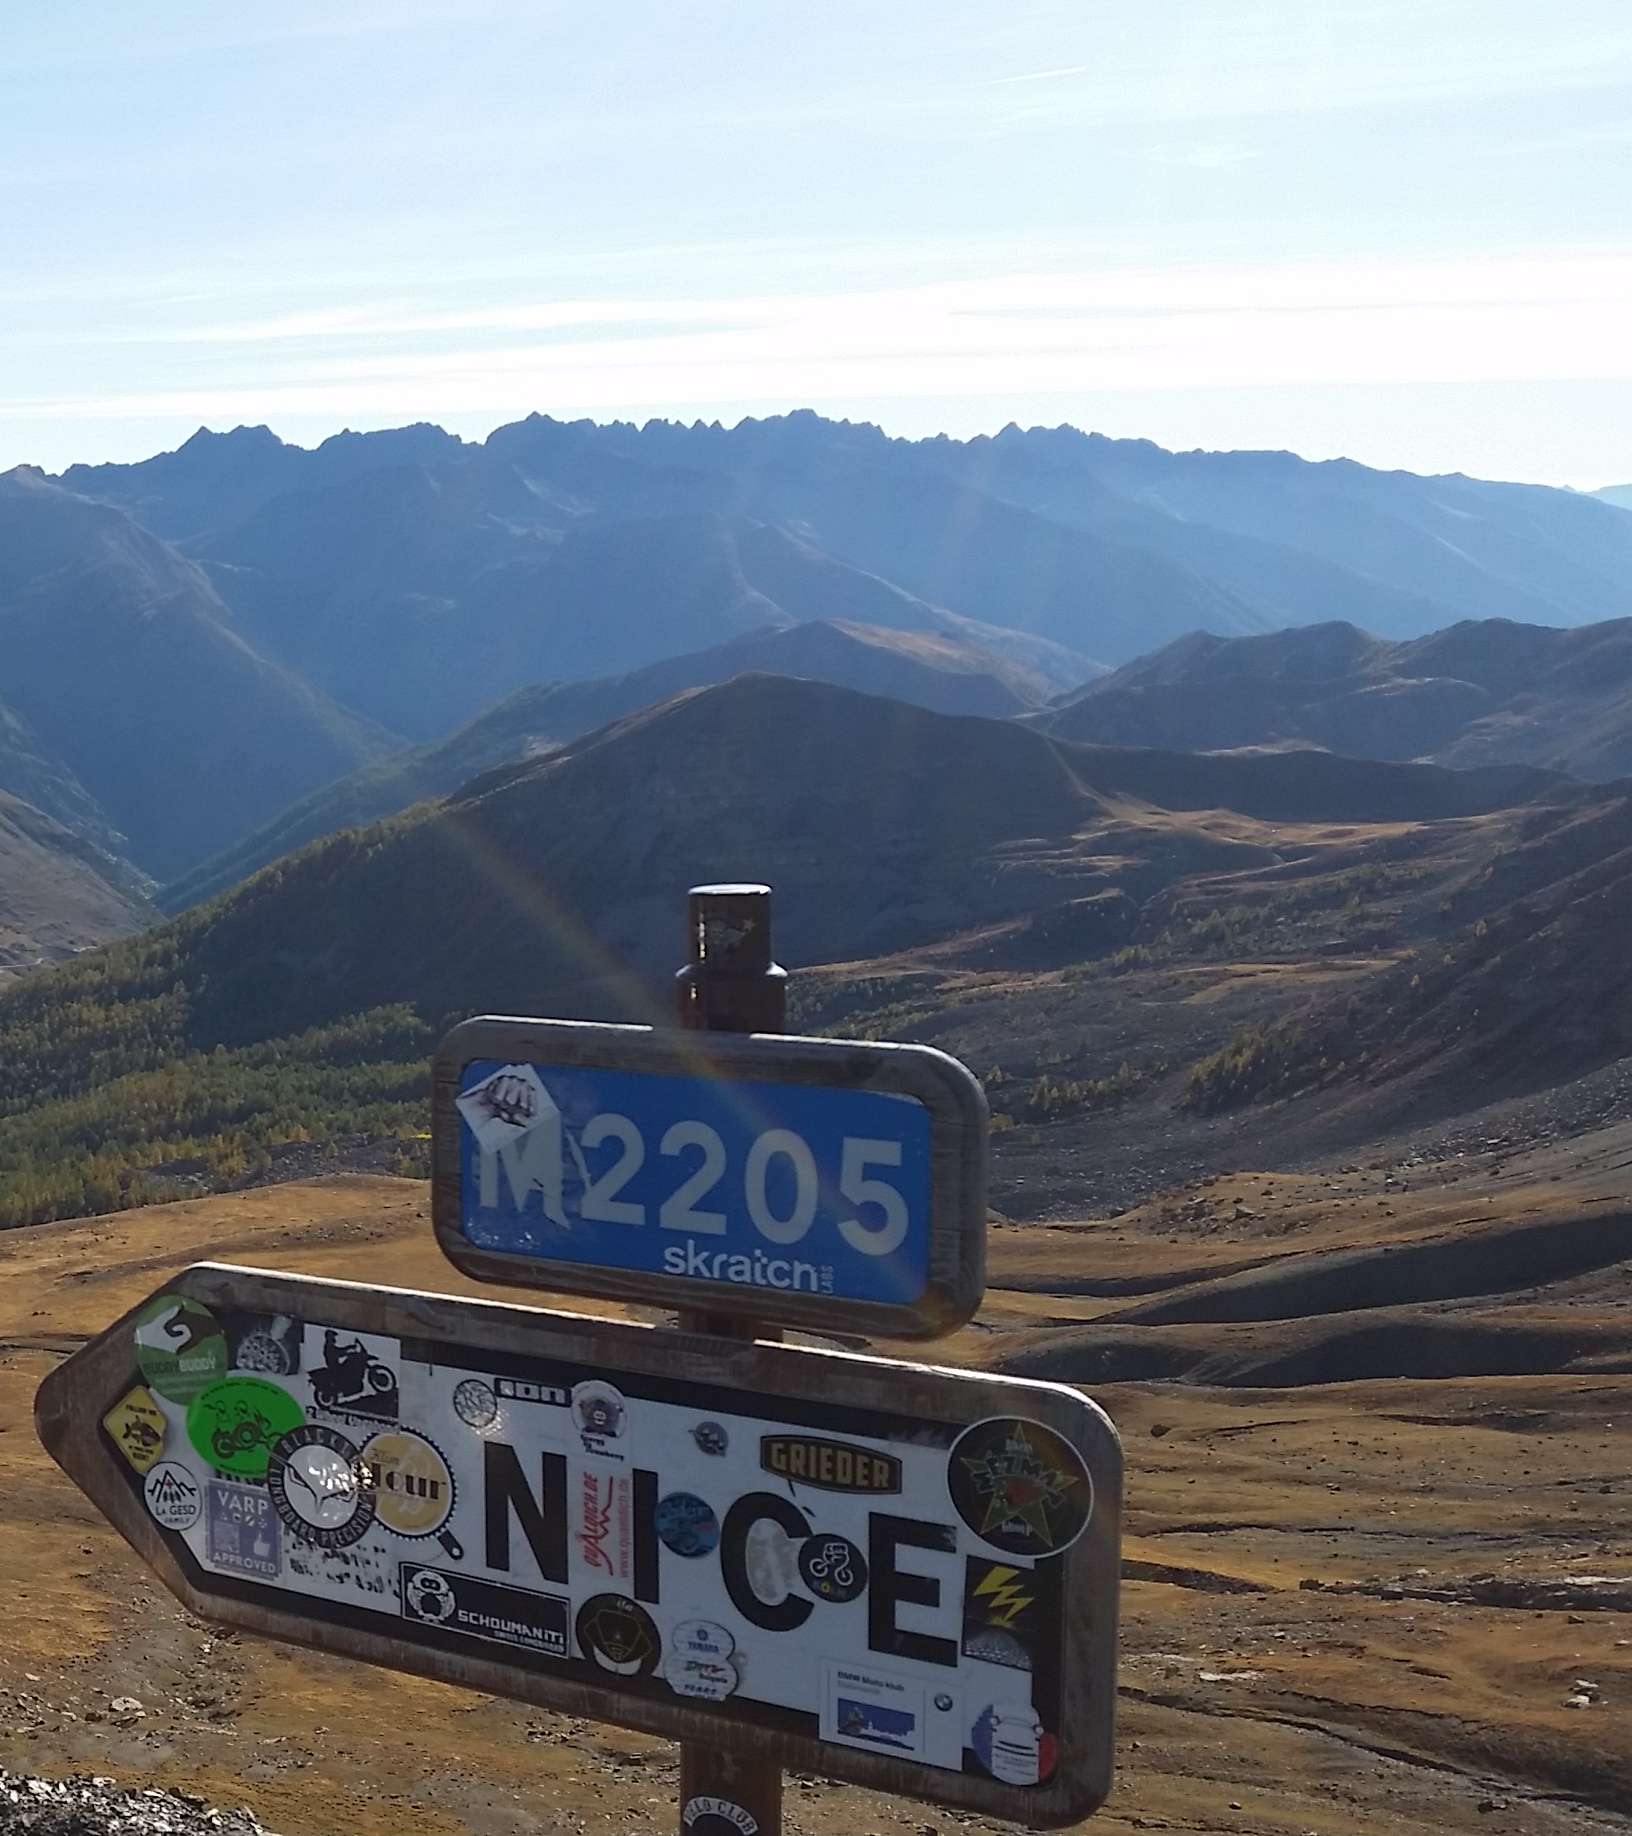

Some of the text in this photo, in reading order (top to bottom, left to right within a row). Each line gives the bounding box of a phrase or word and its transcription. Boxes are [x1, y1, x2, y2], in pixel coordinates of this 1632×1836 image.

[770, 1442, 890, 1488] GRIEDER
[218, 1490, 268, 1516] VARP
[213, 1551, 276, 1574] APPROVED
[484, 1441, 958, 1667] NICE
[718, 1801, 755, 1832] CLUB
